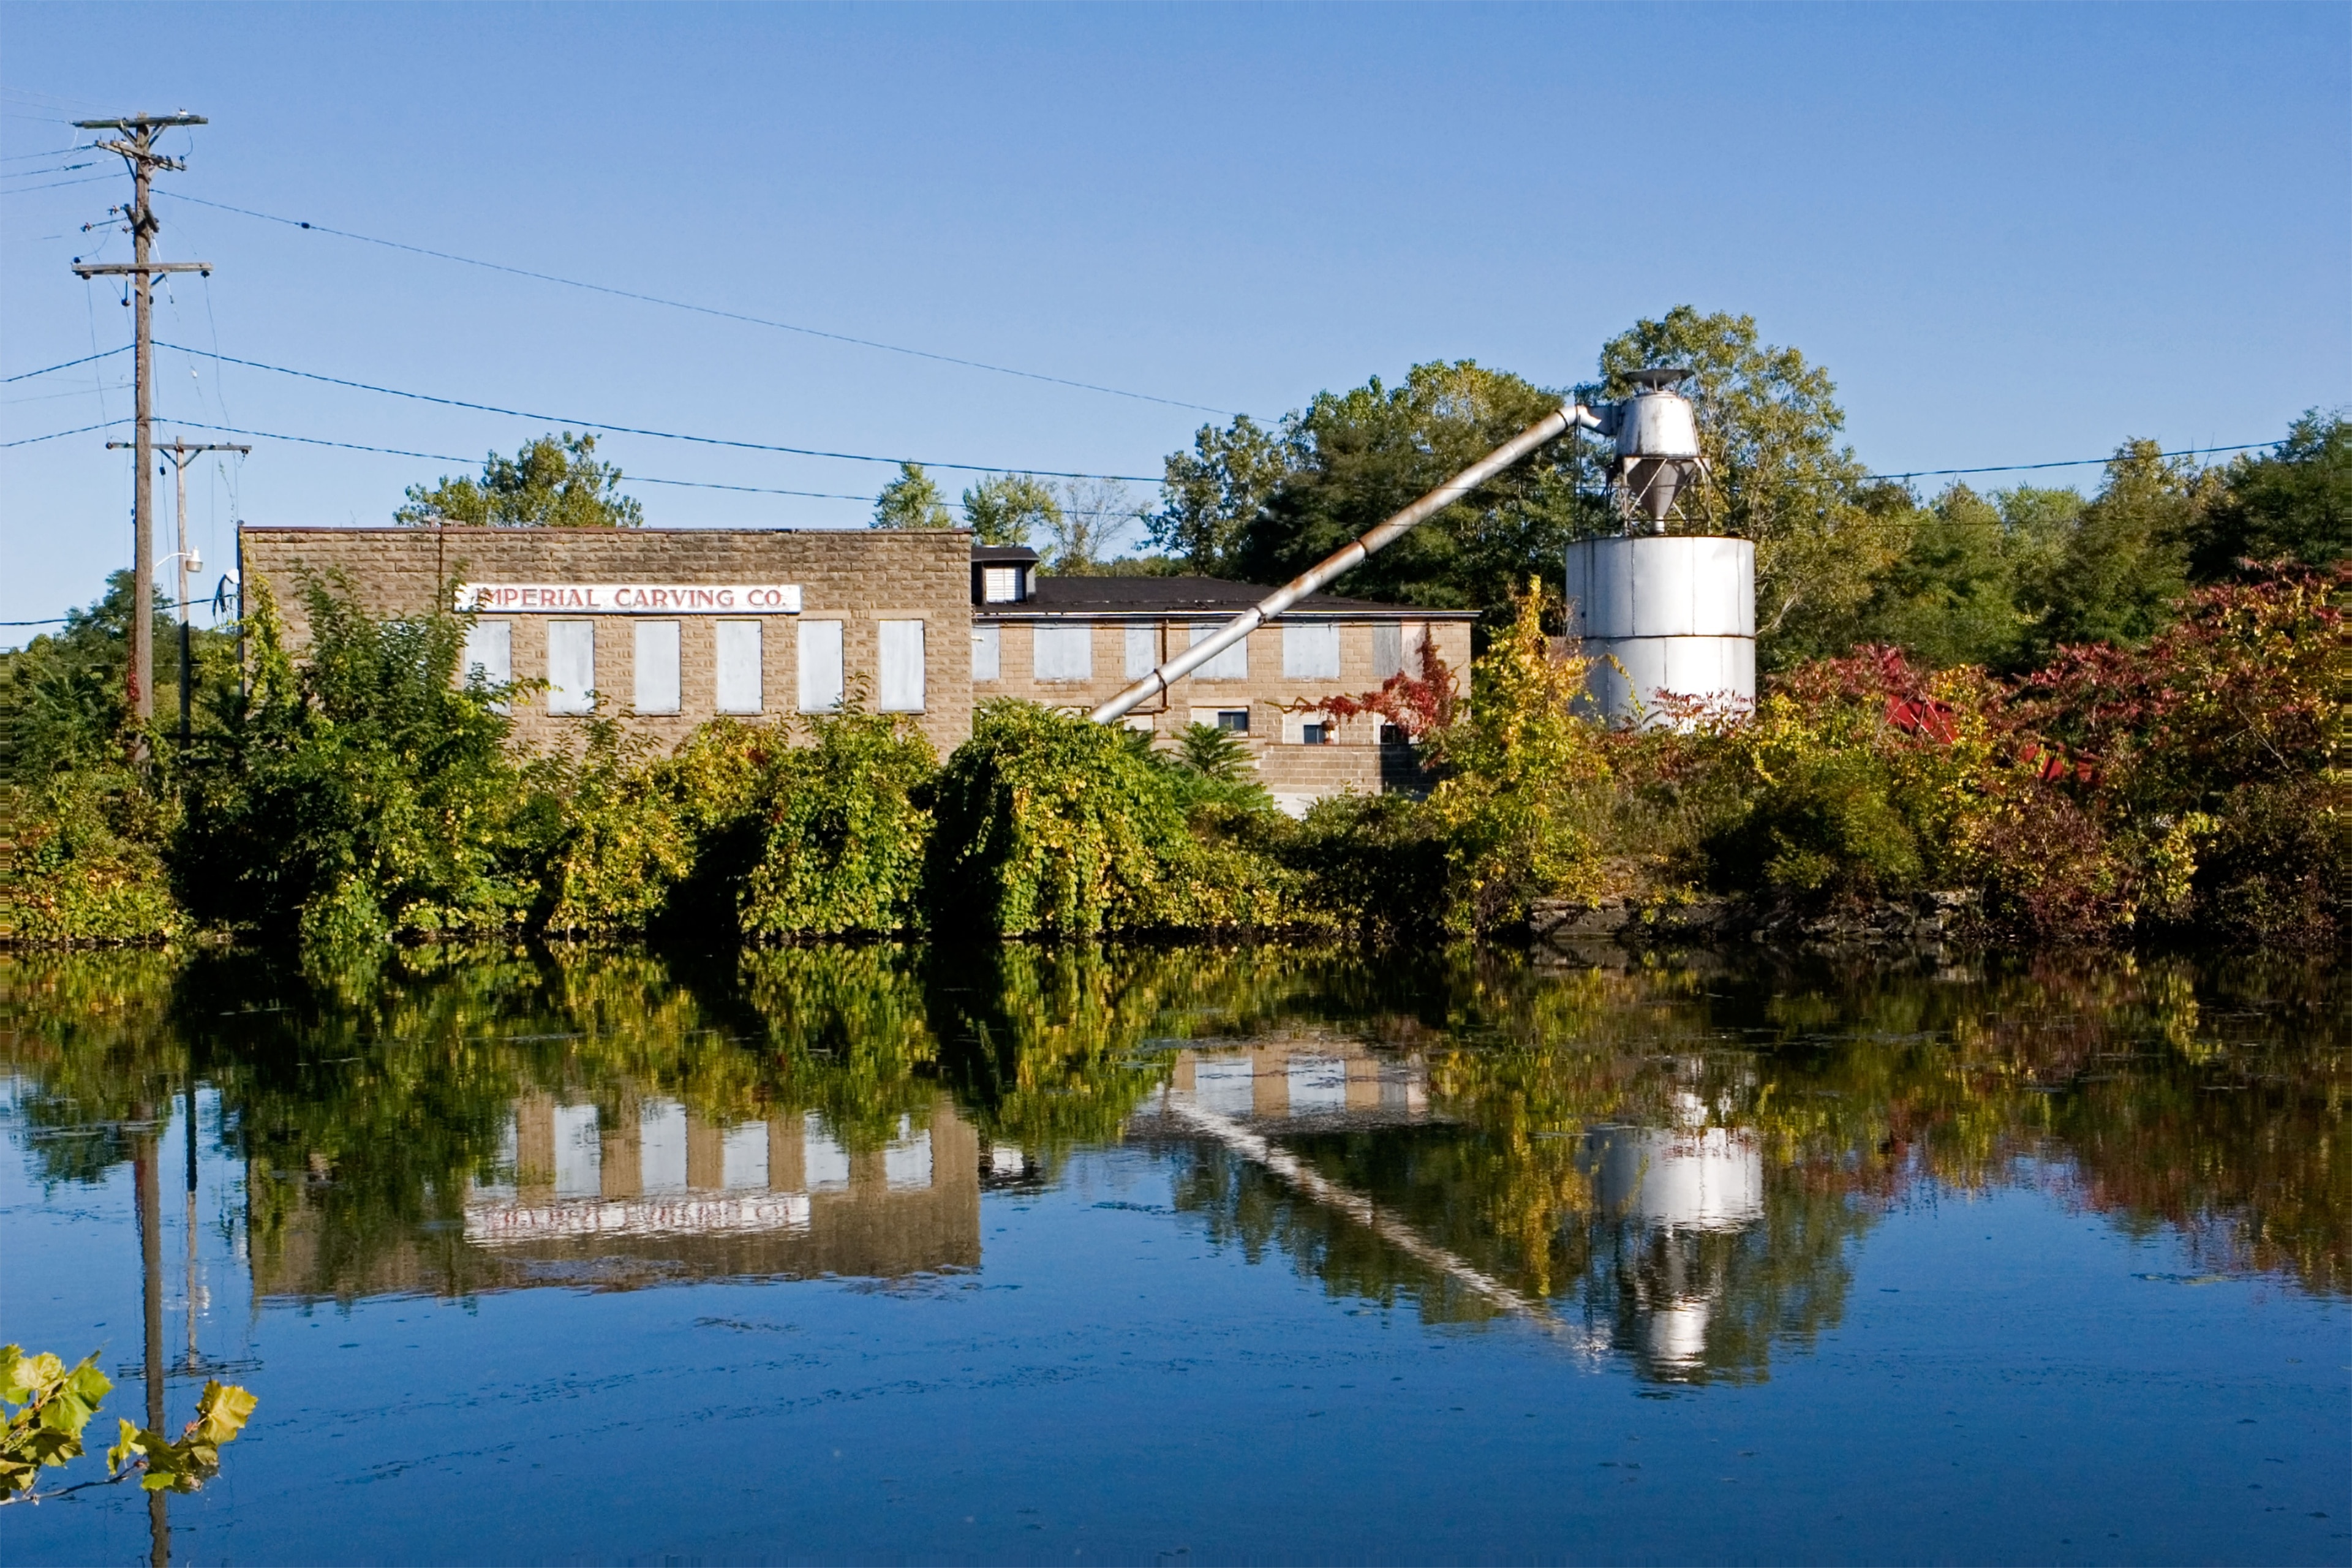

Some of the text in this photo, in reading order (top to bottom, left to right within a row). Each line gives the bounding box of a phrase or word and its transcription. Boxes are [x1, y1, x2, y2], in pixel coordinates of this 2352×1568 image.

[475, 588, 786, 607] IMPERIAL CARVING CO.
